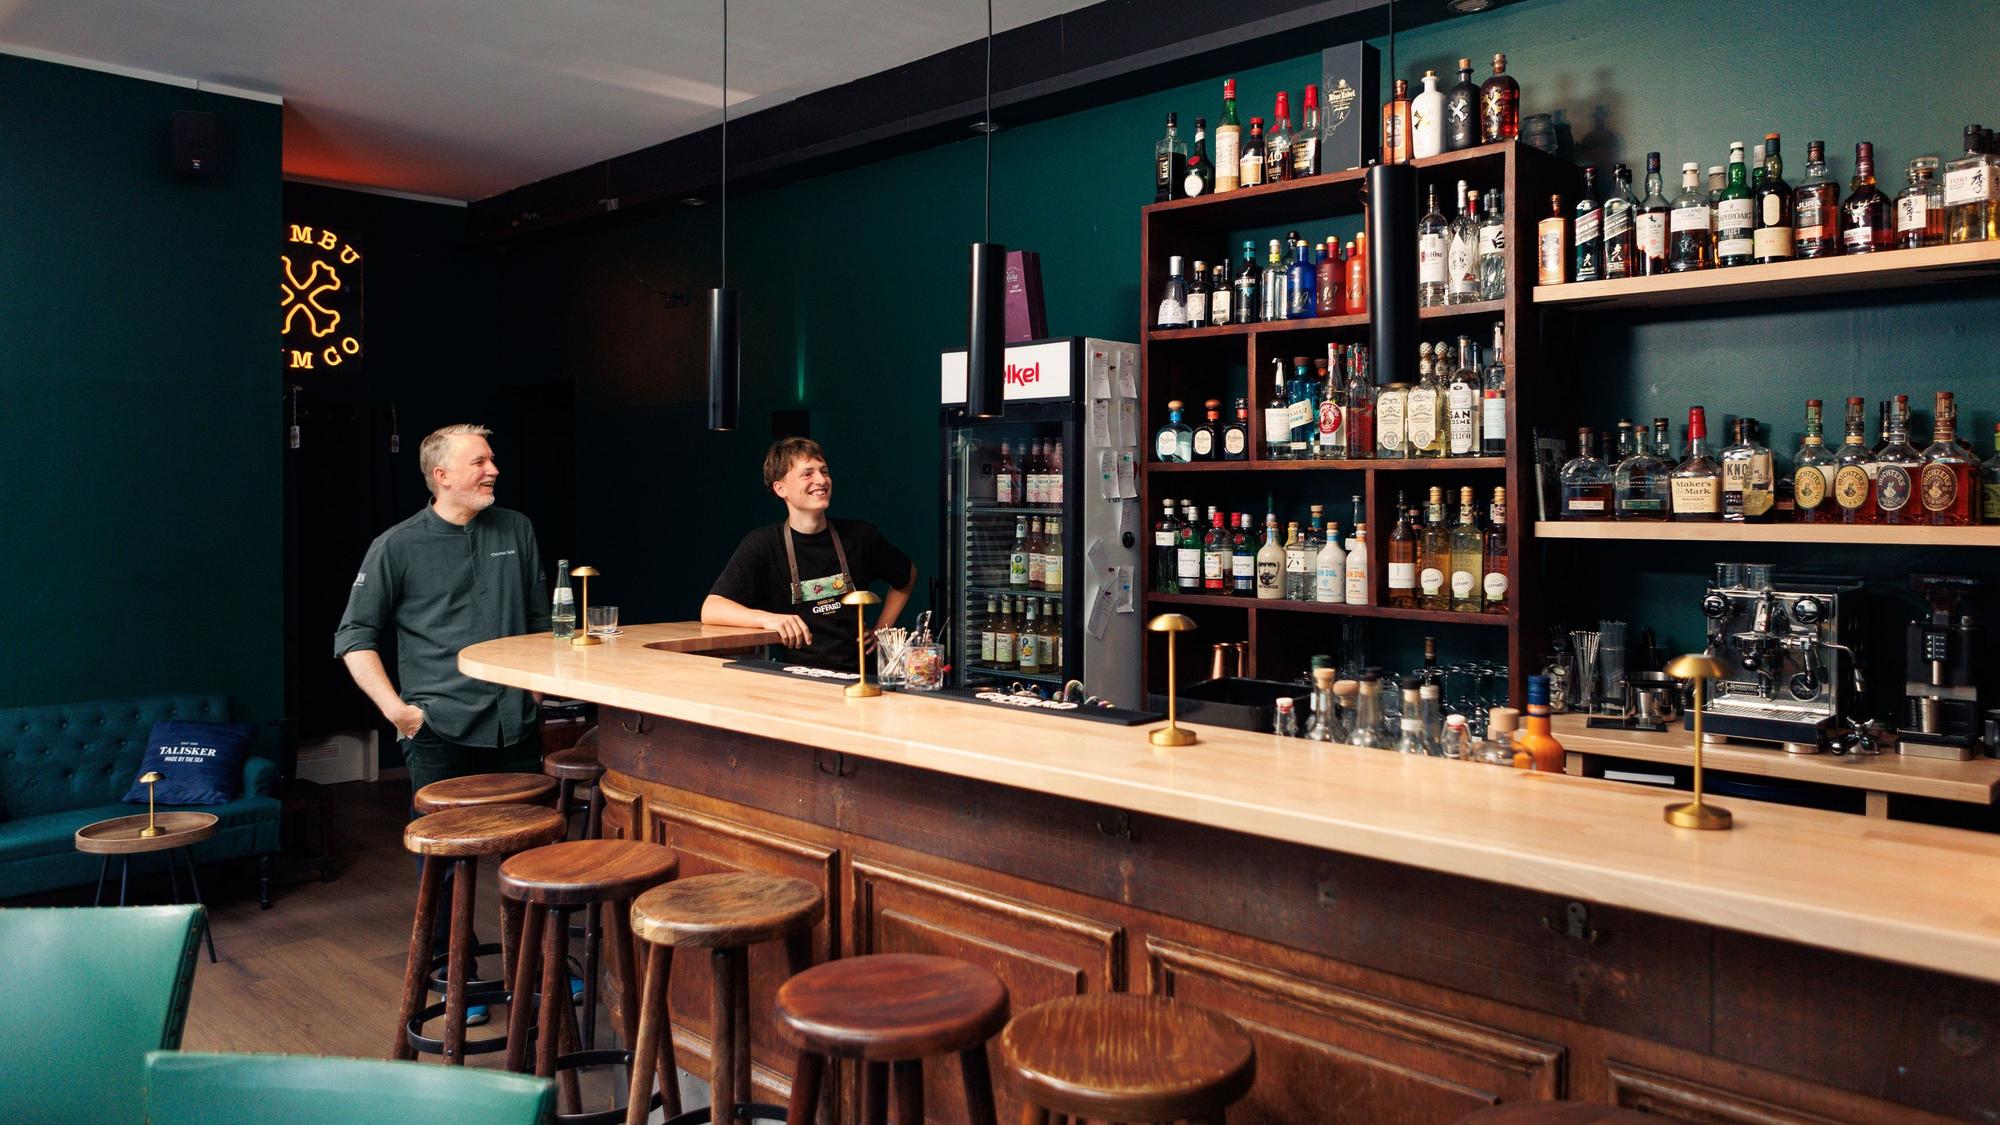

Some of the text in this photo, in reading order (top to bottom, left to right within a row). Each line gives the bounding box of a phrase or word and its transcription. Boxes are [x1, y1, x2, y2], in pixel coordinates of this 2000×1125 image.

[1267, 151, 1283, 166] 46
[1796, 199, 1821, 208] JURA
[289, 224, 361, 264] MBU
[1003, 362, 1040, 386] lkel
[1449, 410, 1471, 419] SAN
[1726, 463, 1749, 476] KNO
[1675, 480, 1712, 488] Maker's
[813, 602, 842, 614] GIFFARD
[160, 746, 216, 756] TALISKER
